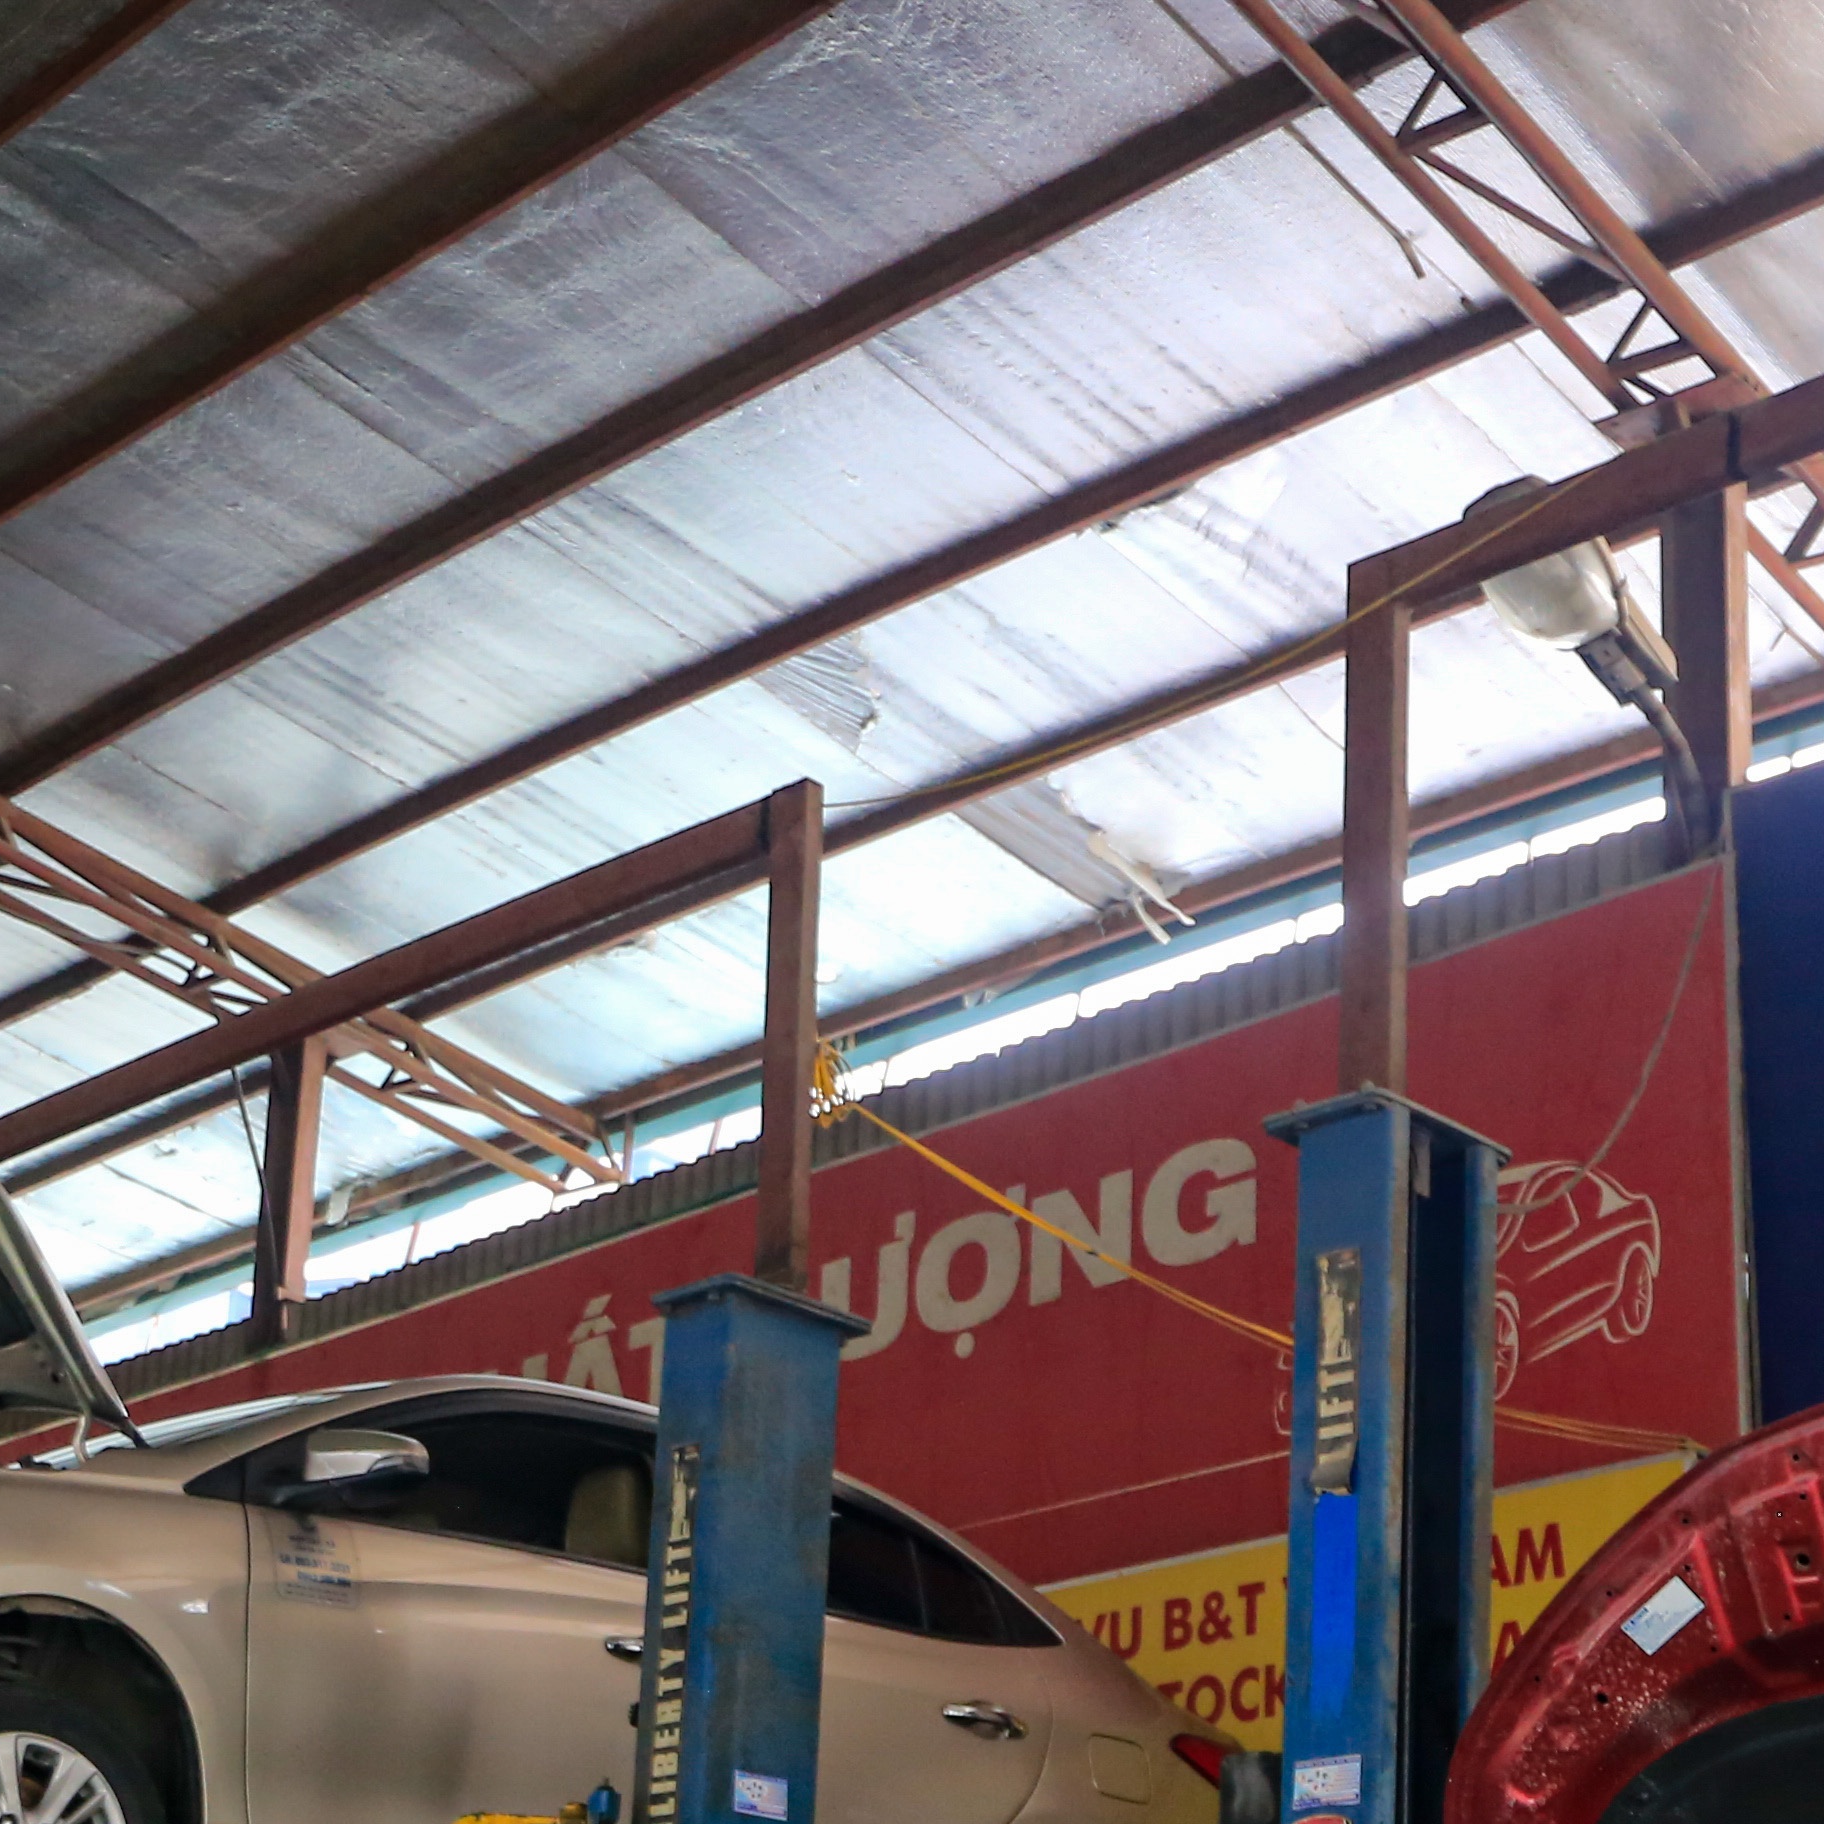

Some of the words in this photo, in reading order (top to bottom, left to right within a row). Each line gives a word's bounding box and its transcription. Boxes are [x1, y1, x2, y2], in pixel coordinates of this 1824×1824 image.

[819, 1137, 1258, 1362] ƯỢNG
[1163, 1582, 1266, 1652] B&T
[1491, 1522, 1566, 1589] AM
[648, 1648, 686, 1818] LIBERTY
